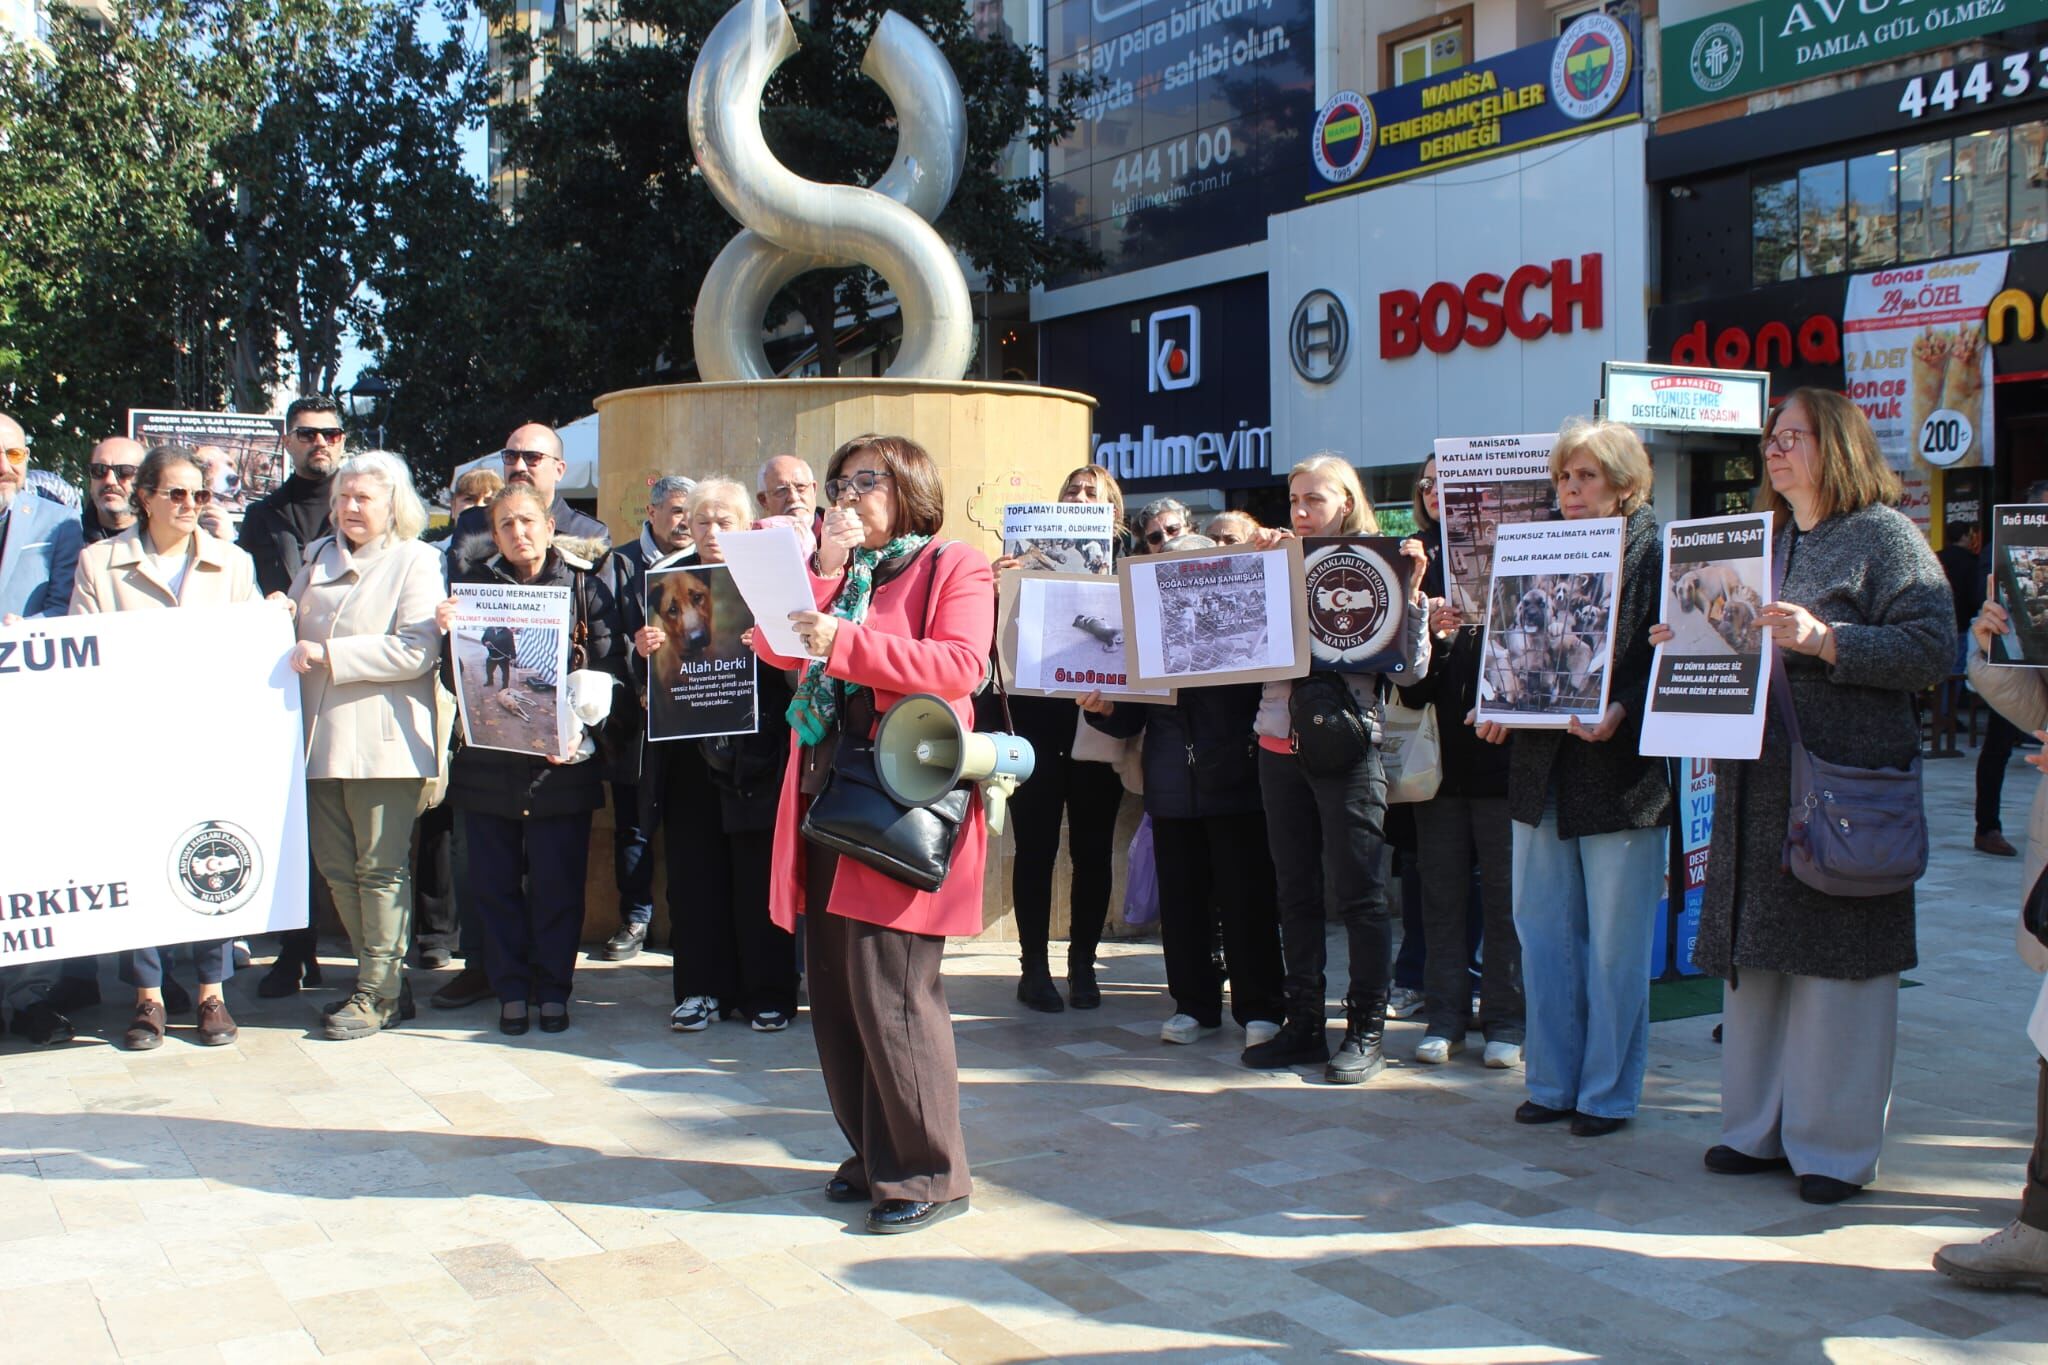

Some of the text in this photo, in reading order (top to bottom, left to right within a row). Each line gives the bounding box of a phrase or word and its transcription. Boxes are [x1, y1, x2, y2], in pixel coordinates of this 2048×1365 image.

[1796, 0, 2007, 65] DAMLA GÜL ÖLMEZ
[1092, 39, 1117, 74] ay
[1120, 20, 1168, 67] para
[1164, 36, 1230, 91] sahibi
[1232, 25, 1291, 67] olun.
[1421, 70, 1498, 109] MANİSA
[1379, 83, 1546, 147] FENERBAHÇELİLER
[1419, 118, 1502, 162] DERNEĞİ
[1112, 126, 1232, 193] 444 11 00
[1333, 166, 1352, 179] 1995
[1917, 282, 1963, 308] ÖZEL
[1379, 252, 1603, 360] BOSCH
[1862, 347, 1908, 371] ADET
[1655, 391, 1721, 408] YUNUS EMRE
[1632, 404, 1697, 421] DESTEĞİNİZLE
[1469, 438, 1521, 448] MANİSA'DA
[1442, 449, 1551, 463] KATLİAM İSTEMİYORUZ
[1438, 468, 1493, 478] TOPLAMAYI
[1007, 505, 1054, 515] TOPLAMAYI
[1056, 506, 1104, 514] DURDURUN
[1006, 525, 1032, 533] DEVLET
[1068, 524, 1106, 533] ÖLDÜRMEZ
[1498, 532, 1544, 541] HUKUKSUZ
[1546, 528, 1587, 538] TALİMATA
[1589, 528, 1616, 536] HAYIR
[1671, 528, 1764, 548] ÖLDÜRME YAŞAT
[1501, 551, 1612, 563] ONLAR RAKAM DEĞİL CAN.
[1159, 579, 1187, 589] DOĞAL
[1188, 577, 1217, 587] YAŞAM
[1316, 557, 1355, 577] HAKLARI
[1355, 559, 1388, 608] PLATFORMU
[453, 588, 568, 600] KAMU GÜCÜ MERHAMETSİZ
[476, 601, 541, 612] KULLANILAMAZ
[1322, 634, 1365, 648] MANİSA
[0, 632, 101, 674] ZÜM
[680, 656, 746, 675] Allah Derki
[1684, 661, 1705, 671] DÜNYA
[1706, 662, 1731, 671] SADECE
[0, 879, 129, 921] RKİYE
[201, 889, 236, 902] MANİSA
